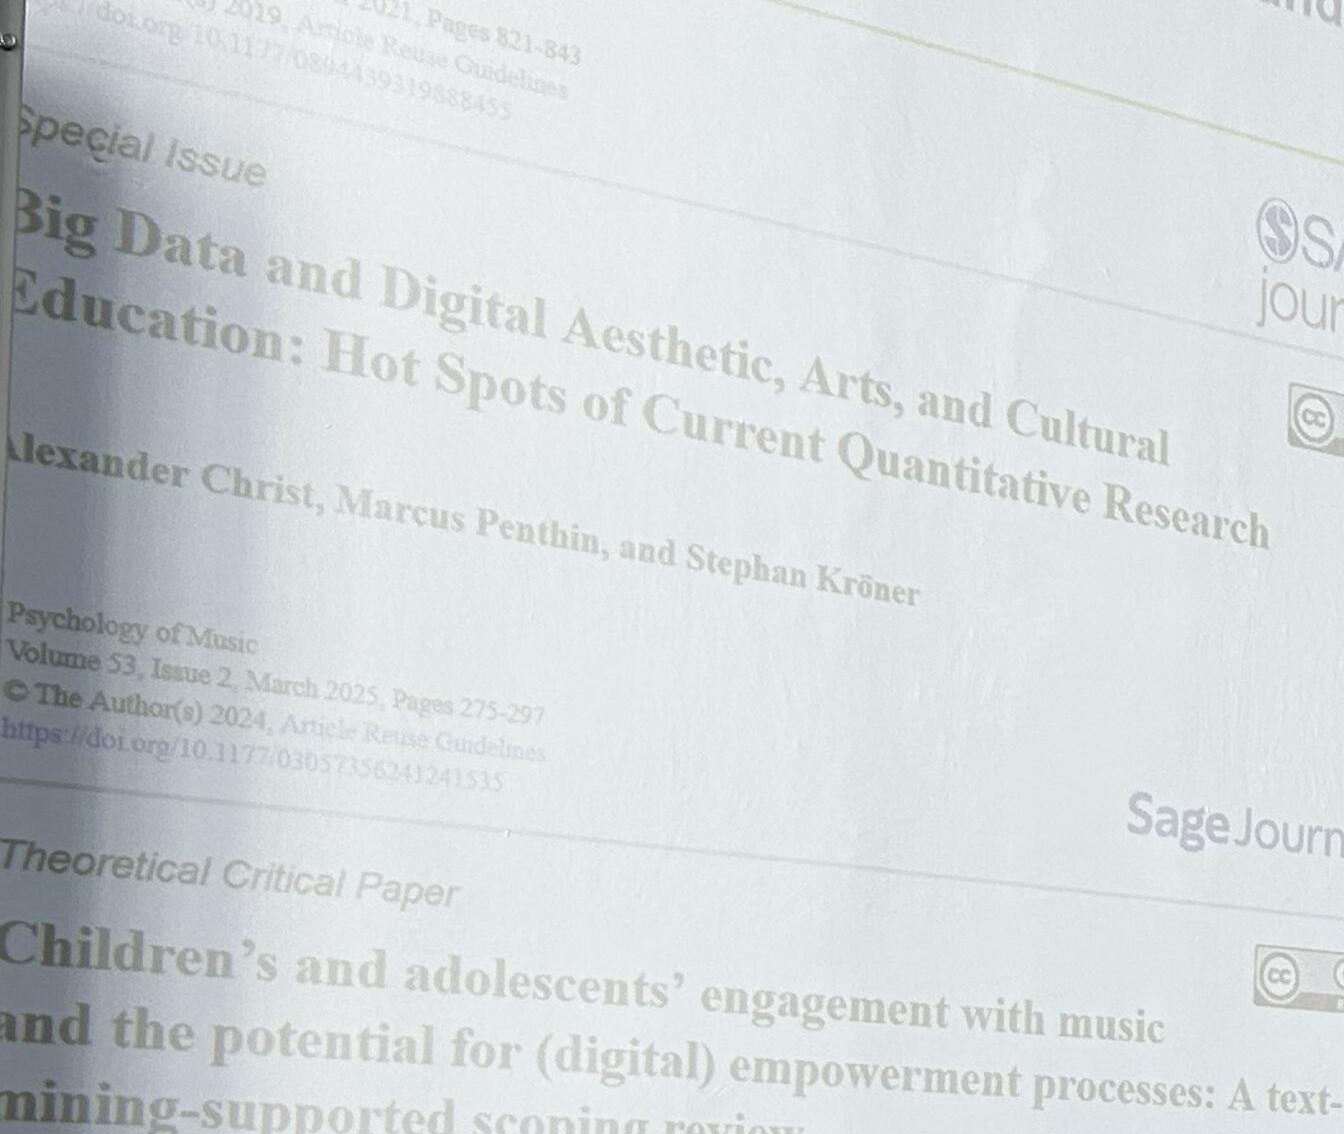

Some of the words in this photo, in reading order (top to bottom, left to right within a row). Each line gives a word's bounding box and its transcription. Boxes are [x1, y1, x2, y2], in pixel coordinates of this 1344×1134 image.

[165, 138, 268, 188] Issue
[115, 207, 247, 278] Data
[266, 255, 362, 300] and
[381, 264, 546, 339] Digital
[561, 306, 785, 395] Aesthetic,
[799, 355, 904, 419] Arts,
[918, 390, 991, 429] and
[1007, 398, 1169, 466] Cultural
[323, 327, 421, 387] Hot
[435, 352, 566, 415] Spots
[583, 386, 633, 426] of
[643, 393, 825, 463] Current
[838, 431, 1091, 514] Quantitative
[1104, 482, 1269, 550] Research
[201, 463, 324, 516] Christ,
[335, 483, 465, 532] Marcus
[476, 507, 609, 561] Penthin,
[620, 538, 676, 566] and
[686, 543, 806, 589] Stephan
[817, 564, 921, 606] Kröner
[8, 640, 101, 672] Volume
[109, 653, 144, 681] 53,
[151, 656, 211, 686] Issue
[217, 665, 239, 694] 2,
[245, 669, 318, 699] March
[324, 679, 384, 711] 2025,
[392, 687, 454, 716] Pages
[460, 697, 545, 725] 275-297
[188, 626, 258, 655] Music
[34, 682, 84, 710] The
[210, 703, 273, 735] 2024,
[280, 714, 357, 741] Article
[362, 721, 430, 749] Reuse
[435, 730, 546, 762] Guidelines
[0, 838, 212, 886] Theoretical
[223, 859, 346, 897] Critical
[356, 870, 461, 910] Paper
[296, 948, 386, 989] and
[701, 986, 950, 1031] engagement
[961, 996, 1045, 1036] with
[1059, 1008, 1164, 1043] music
[0, 1004, 91, 1046] and
[112, 1007, 195, 1051] the
[211, 1020, 434, 1068] potential
[451, 1027, 522, 1070] for
[537, 1033, 715, 1090] (digital)
[730, 1056, 1022, 1098] empowerment
[1032, 1074, 1214, 1110] processes:
[1228, 1077, 1255, 1111] A
[1267, 1083, 1342, 1115] text-
